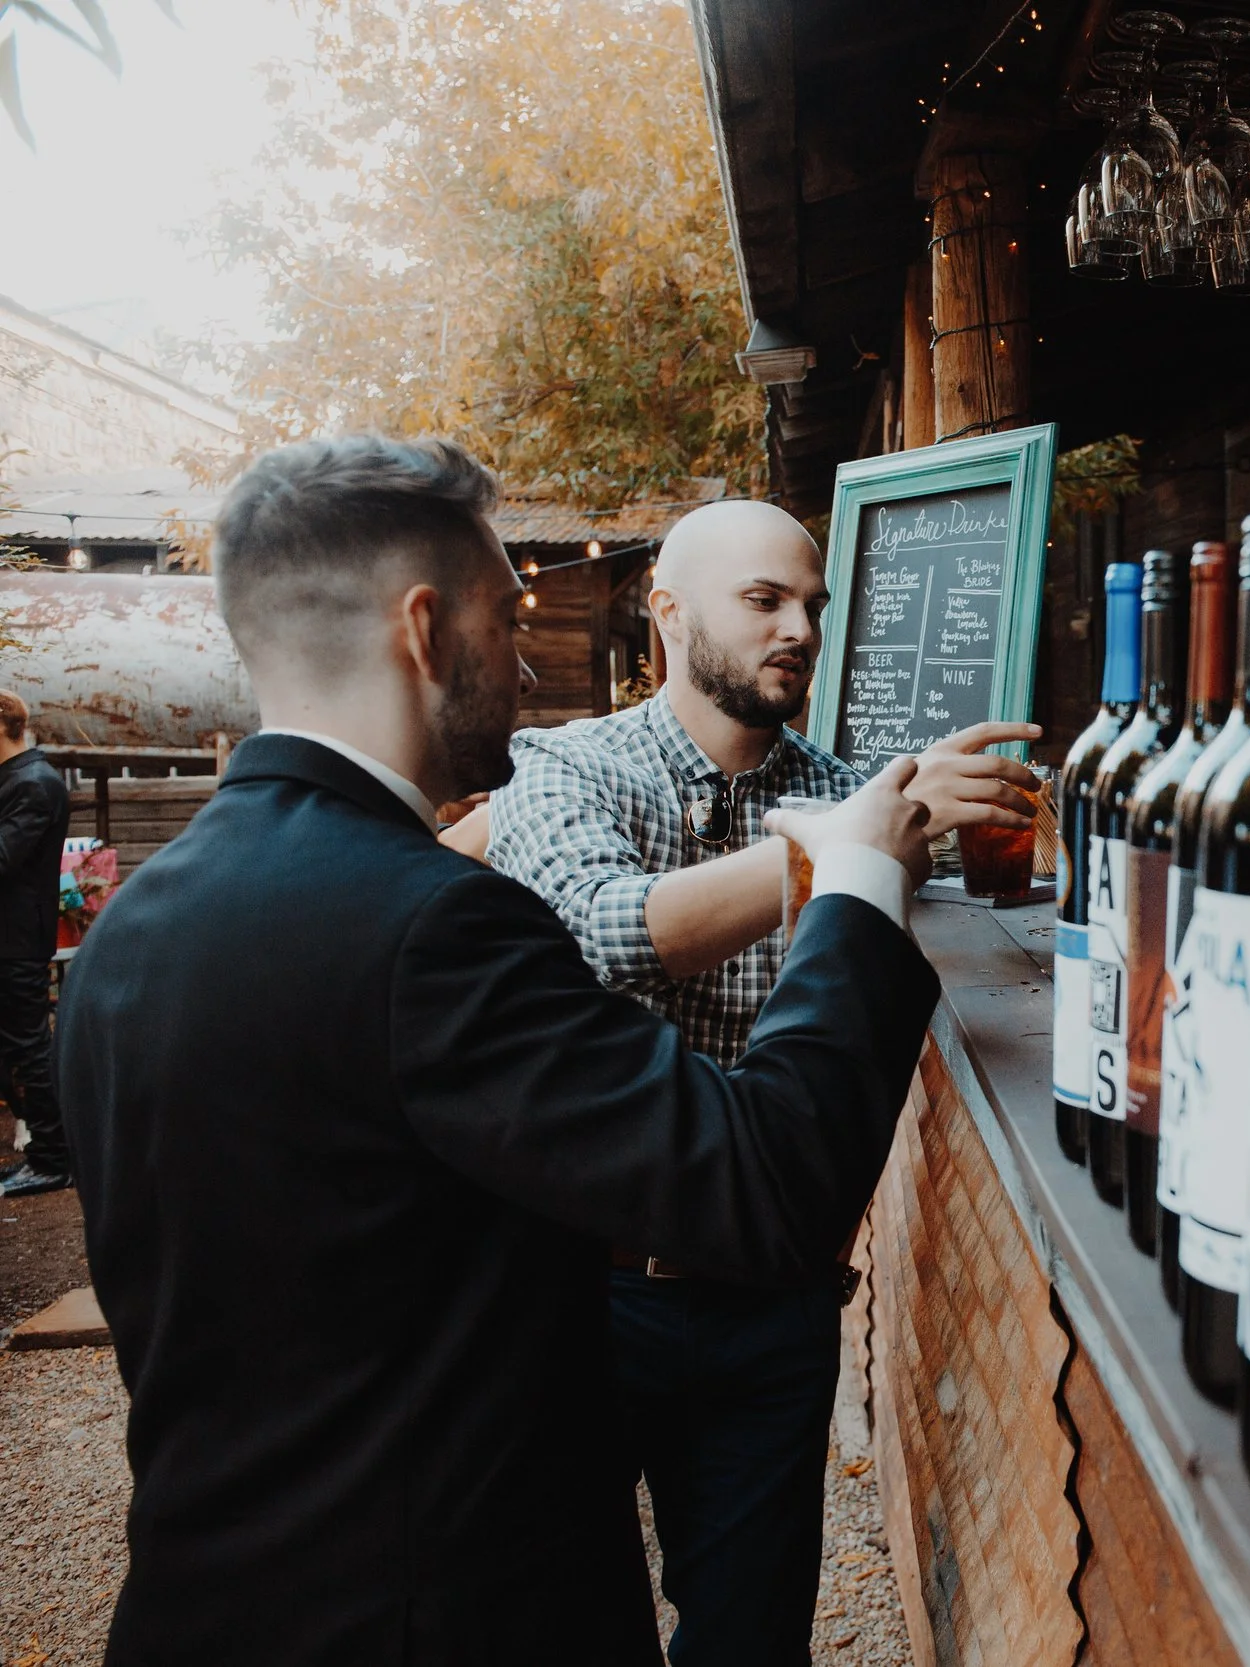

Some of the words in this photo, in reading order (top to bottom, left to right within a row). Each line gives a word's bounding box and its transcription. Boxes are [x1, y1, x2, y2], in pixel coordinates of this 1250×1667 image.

[871, 507, 947, 561] Signature
[948, 500, 1009, 538] Drinks
[955, 556, 968, 577] The
[963, 576, 993, 588] BRIDE
[870, 625, 886, 637] Lime
[868, 652, 894, 667] BEER
[942, 667, 976, 686] WINE
[926, 706, 950, 720] White
